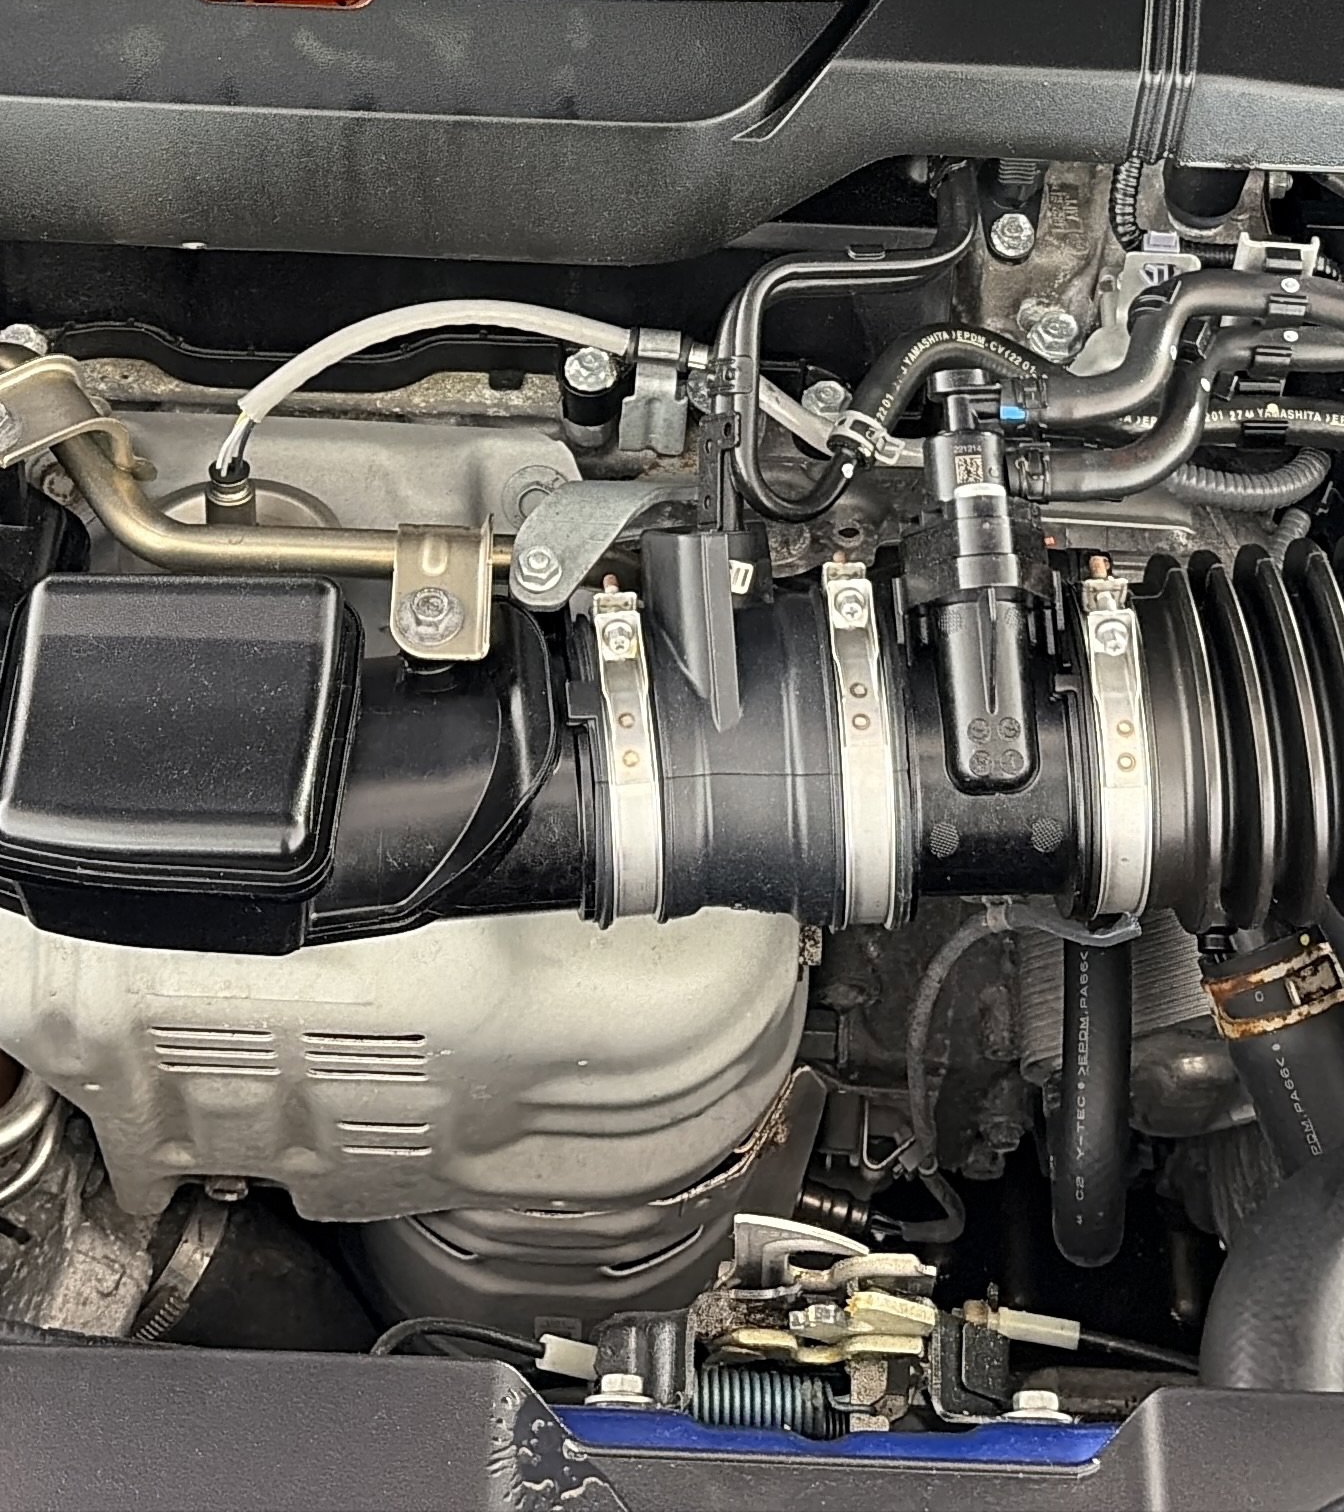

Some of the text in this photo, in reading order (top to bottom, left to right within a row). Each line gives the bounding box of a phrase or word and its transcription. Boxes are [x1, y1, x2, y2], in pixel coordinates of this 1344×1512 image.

[902, 330, 950, 366] YAMASHITA
[953, 444, 982, 454] 221214
[1076, 1096, 1087, 1160] Y-TEC
